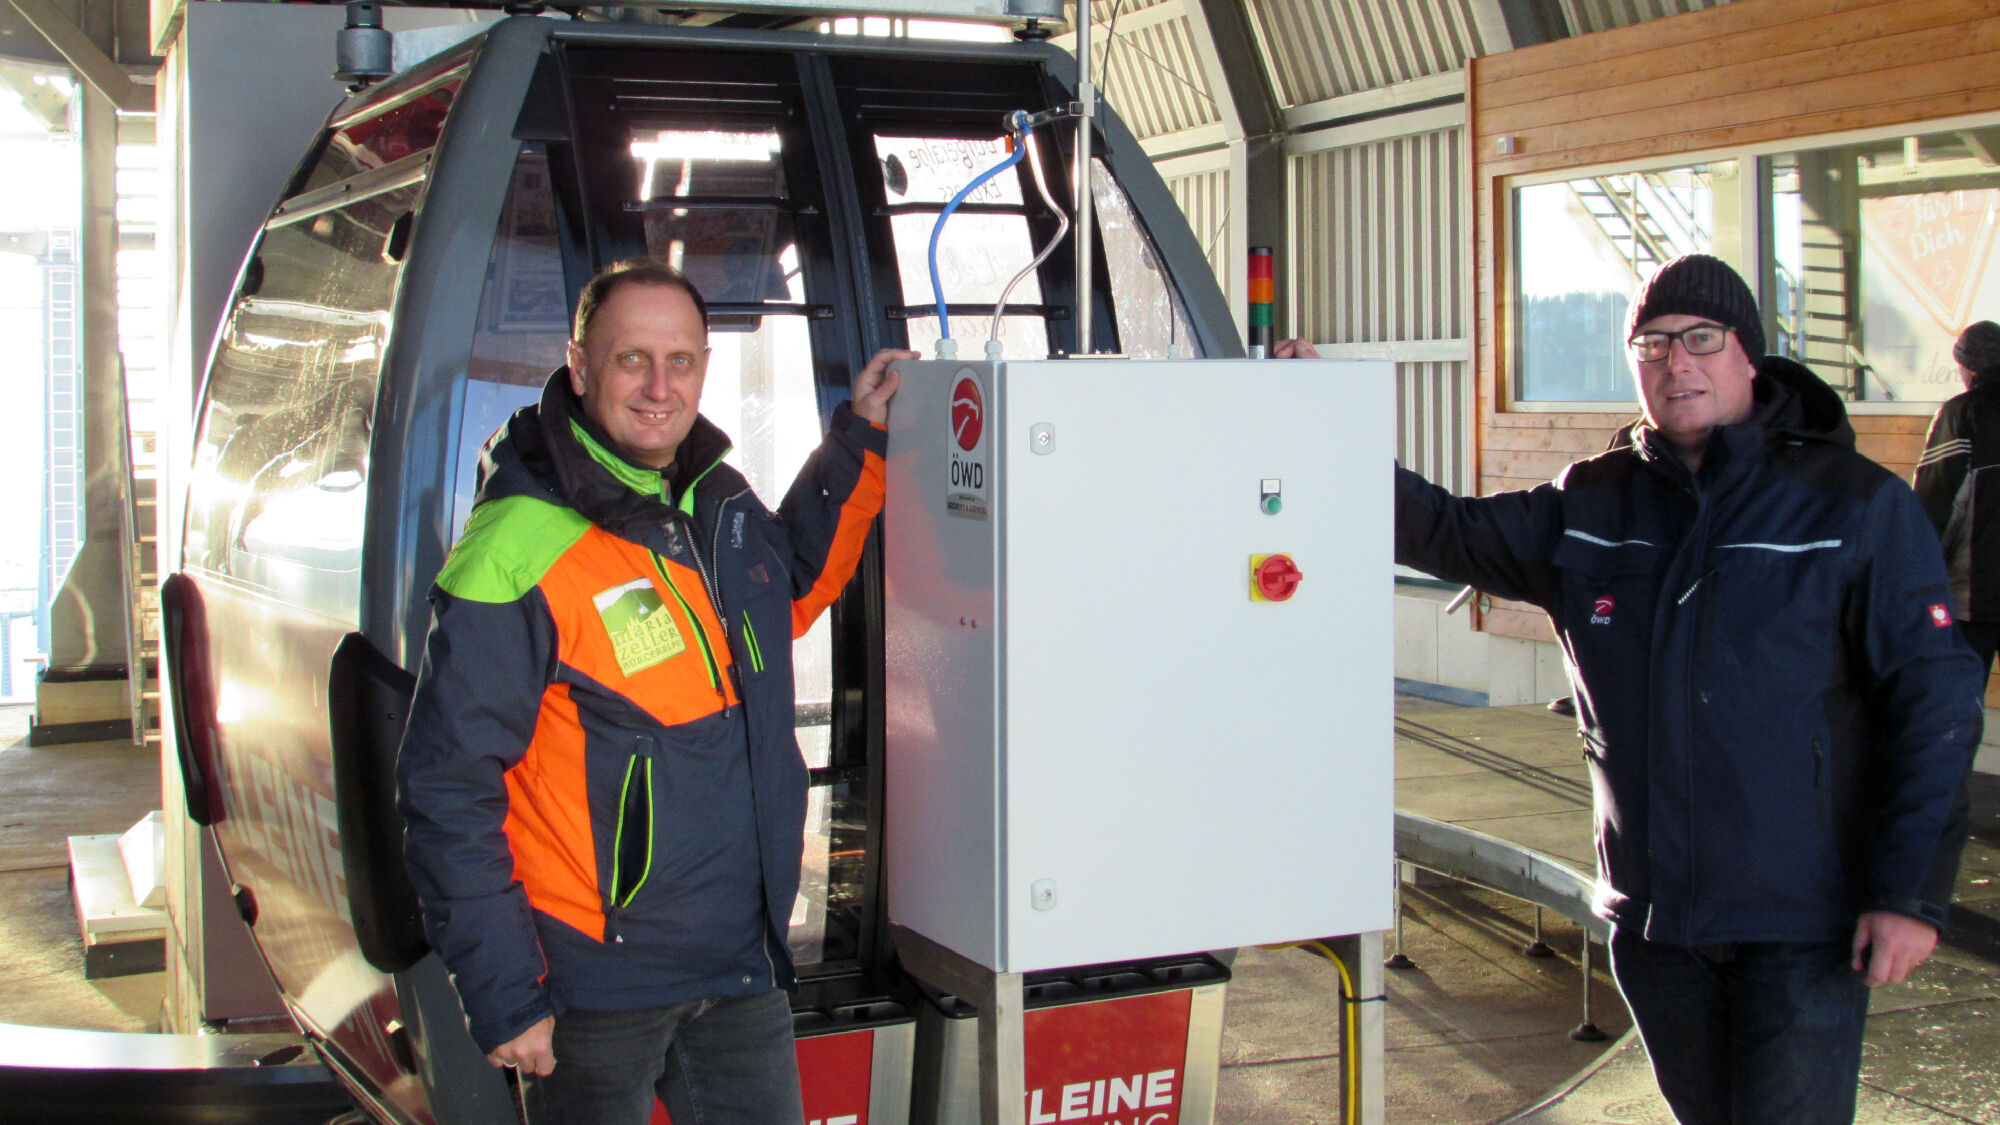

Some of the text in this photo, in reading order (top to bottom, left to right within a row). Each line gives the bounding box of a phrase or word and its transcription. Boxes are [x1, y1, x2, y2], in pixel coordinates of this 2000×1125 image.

[1909, 220, 1965, 260] Dich
[951, 453, 983, 489] ÖWD
[1590, 613, 1611, 625] ÖWD
[1025, 1069, 1175, 1125] LEINE
